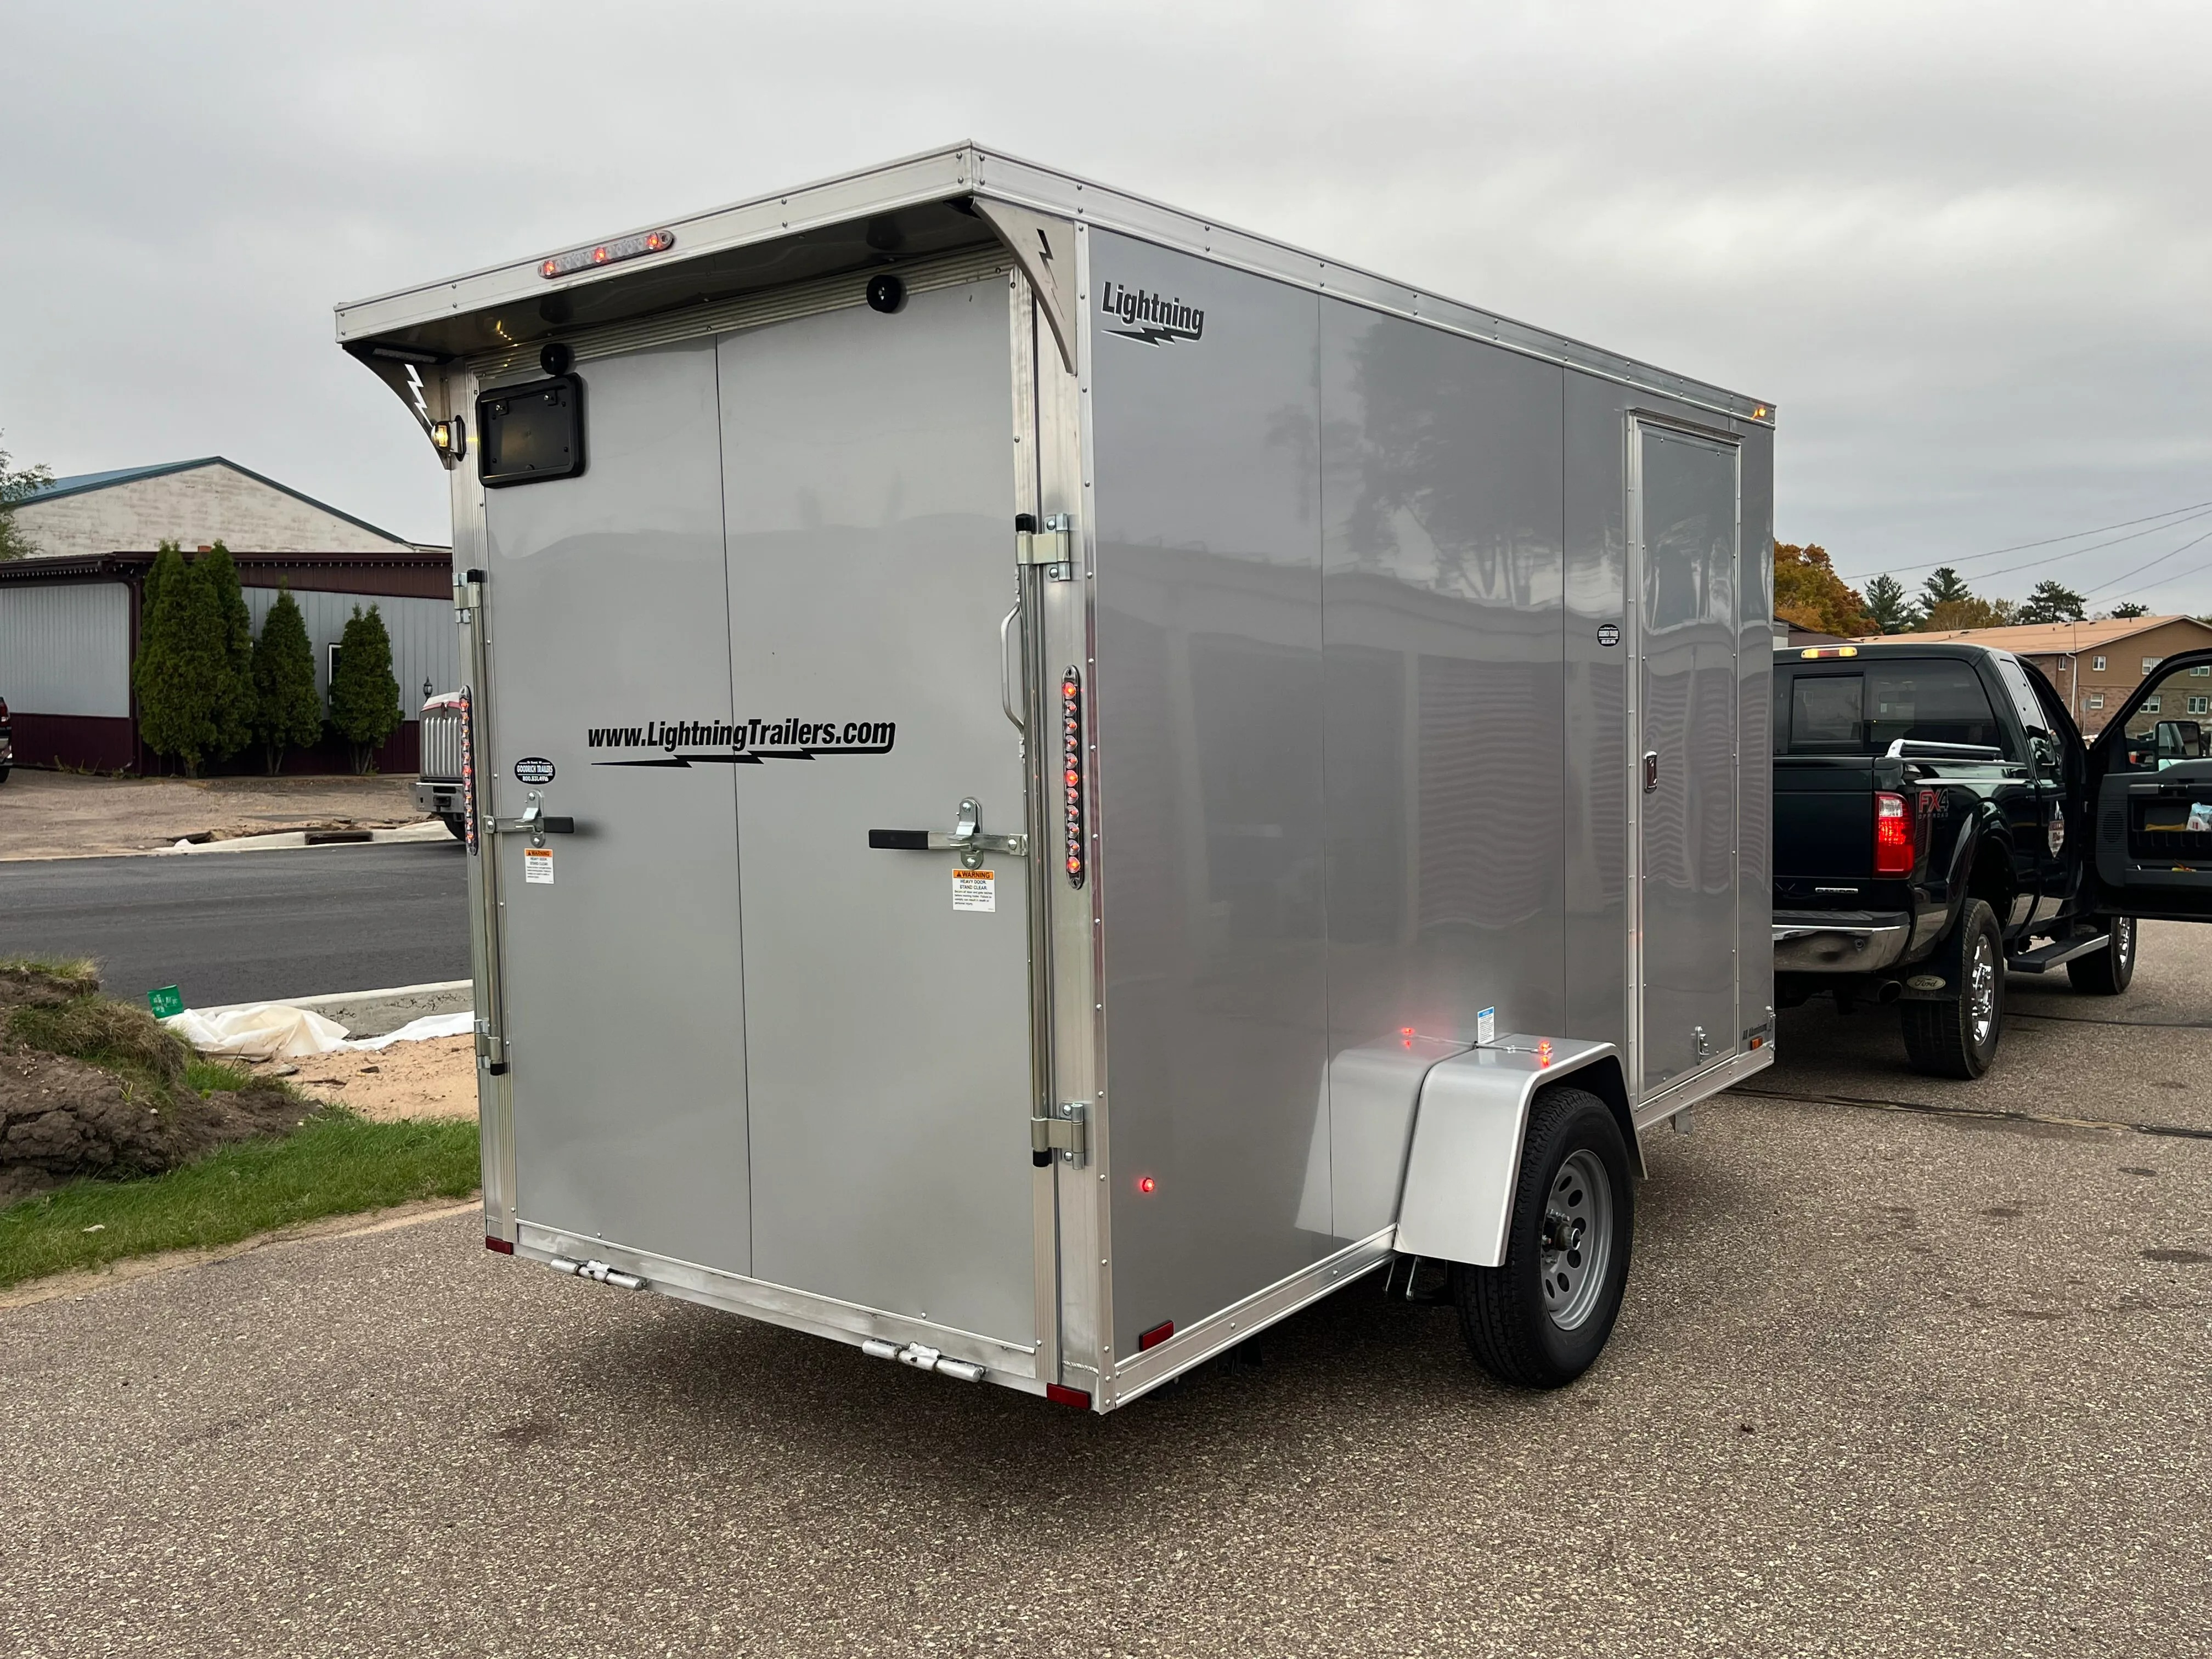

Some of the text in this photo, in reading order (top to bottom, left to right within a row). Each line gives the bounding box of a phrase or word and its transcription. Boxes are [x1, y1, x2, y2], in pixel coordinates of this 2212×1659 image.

[1102, 281, 1204, 337] Lightning
[588, 718, 896, 752] www.LightningTrailers.com
[1918, 788, 1949, 813] FX4
[1915, 978, 1938, 987] Ford
